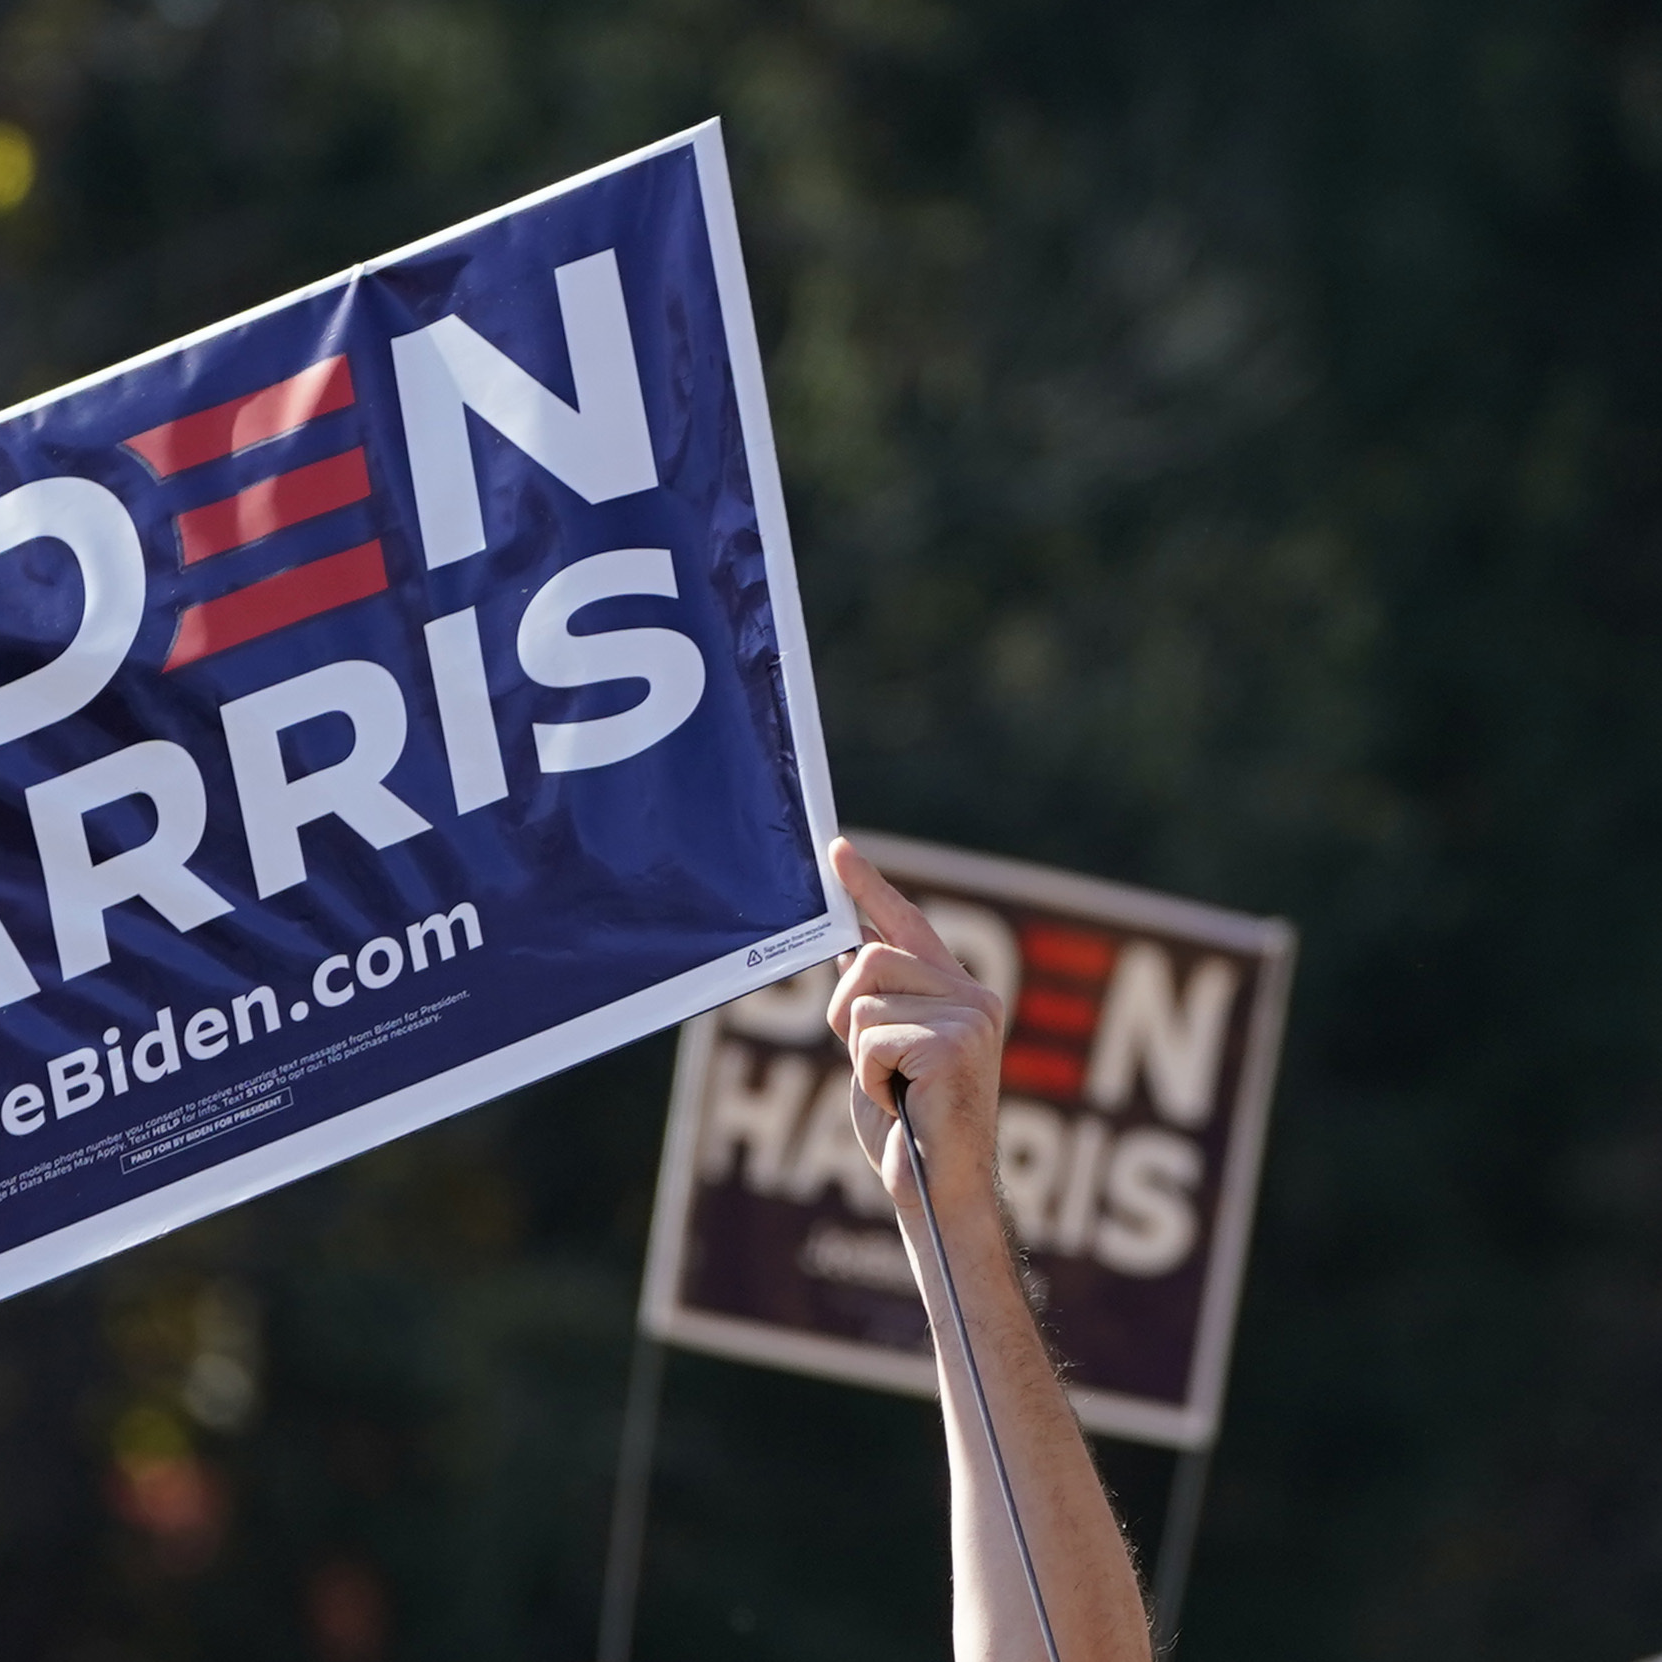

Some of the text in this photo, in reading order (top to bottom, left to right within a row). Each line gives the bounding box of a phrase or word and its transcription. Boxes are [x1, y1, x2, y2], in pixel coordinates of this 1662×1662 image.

[10, 1185, 18, 1195] &
[19, 1176, 42, 1191] Data
[44, 1164, 72, 1181] Rates
[74, 1155, 94, 1169] May
[97, 1142, 127, 1160] Apply.
[128, 1131, 150, 1145] Text
[152, 1118, 180, 1136] HELP
[182, 1112, 196, 1124] for
[222, 1092, 243, 1107] Text
[246, 1080, 274, 1097] STOP
[275, 1076, 286, 1085] to
[288, 1067, 304, 1080] opt
[306, 1060, 326, 1073] out.
[328, 1052, 342, 1064] No
[344, 1034, 388, 1059] purchase
[390, 1013, 442, 1038] necessary.
[19, 1162, 52, 1180] mobile
[54, 1149, 84, 1168] phone
[86, 1132, 122, 1153] number
[125, 1124, 143, 1139] you
[145, 1107, 185, 1129] consent
[185, 1103, 196, 1112] to
[198, 1087, 232, 1107] receive
[234, 1068, 278, 1092] recurring
[279, 1060, 297, 1074] text
[300, 1040, 347, 1065] messages
[349, 1030, 373, 1045] from
[374, 1018, 402, 1035] Biden
[404, 1011, 418, 1022] for
[420, 990, 470, 1015] President.
[131, 1095, 281, 1164] PAID FOR BY BIDEN FOR PRESIDENT
[697, 1042, 1207, 1279] HARIS
